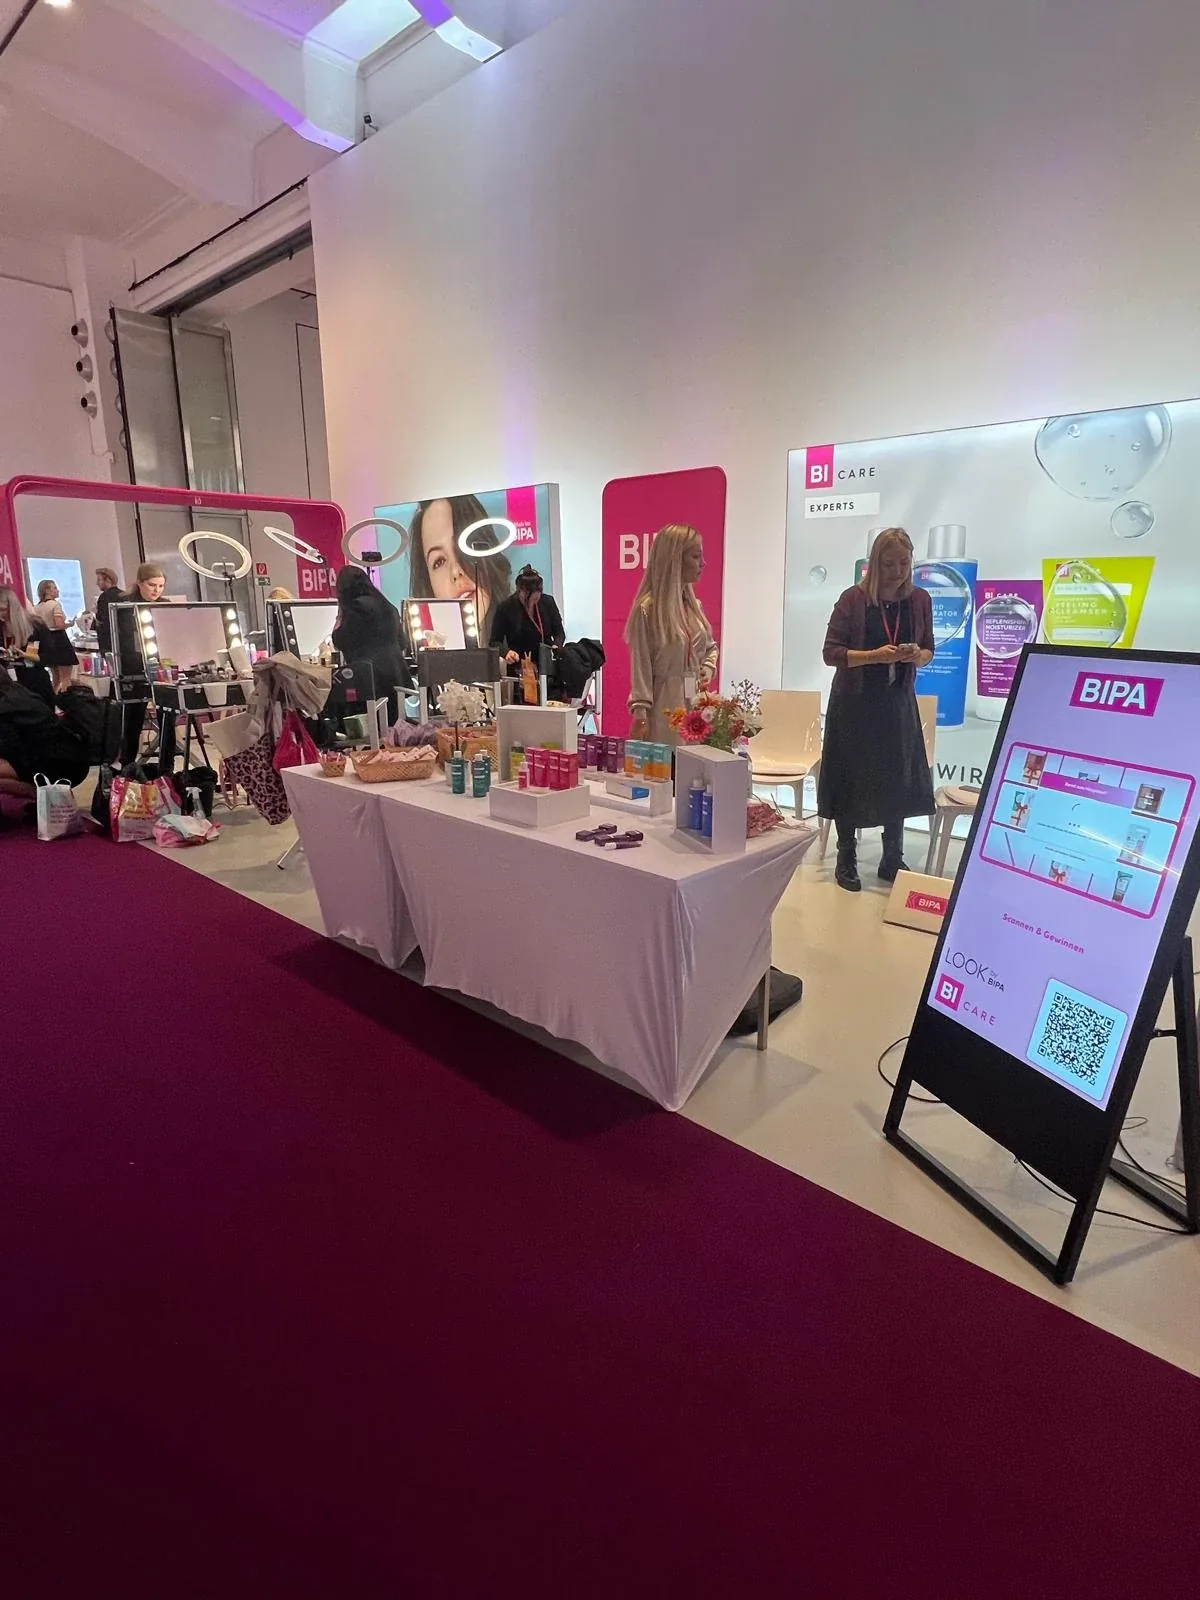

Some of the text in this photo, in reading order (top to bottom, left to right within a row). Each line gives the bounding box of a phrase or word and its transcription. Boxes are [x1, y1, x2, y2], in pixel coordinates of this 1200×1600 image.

[810, 464, 876, 483] BI CARE
[810, 502, 854, 512] EXPERTS
[619, 533, 658, 570] BI
[302, 567, 337, 592] BIPA
[1079, 678, 1146, 710] BIPA
[936, 762, 984, 785] WIR
[918, 897, 942, 911] BIPA
[1002, 913, 1085, 955] Scannen & Gewinnen
[944, 948, 989, 983] LOOK
[987, 977, 1006, 992] BIPA
[940, 980, 997, 1026] BI CARE
